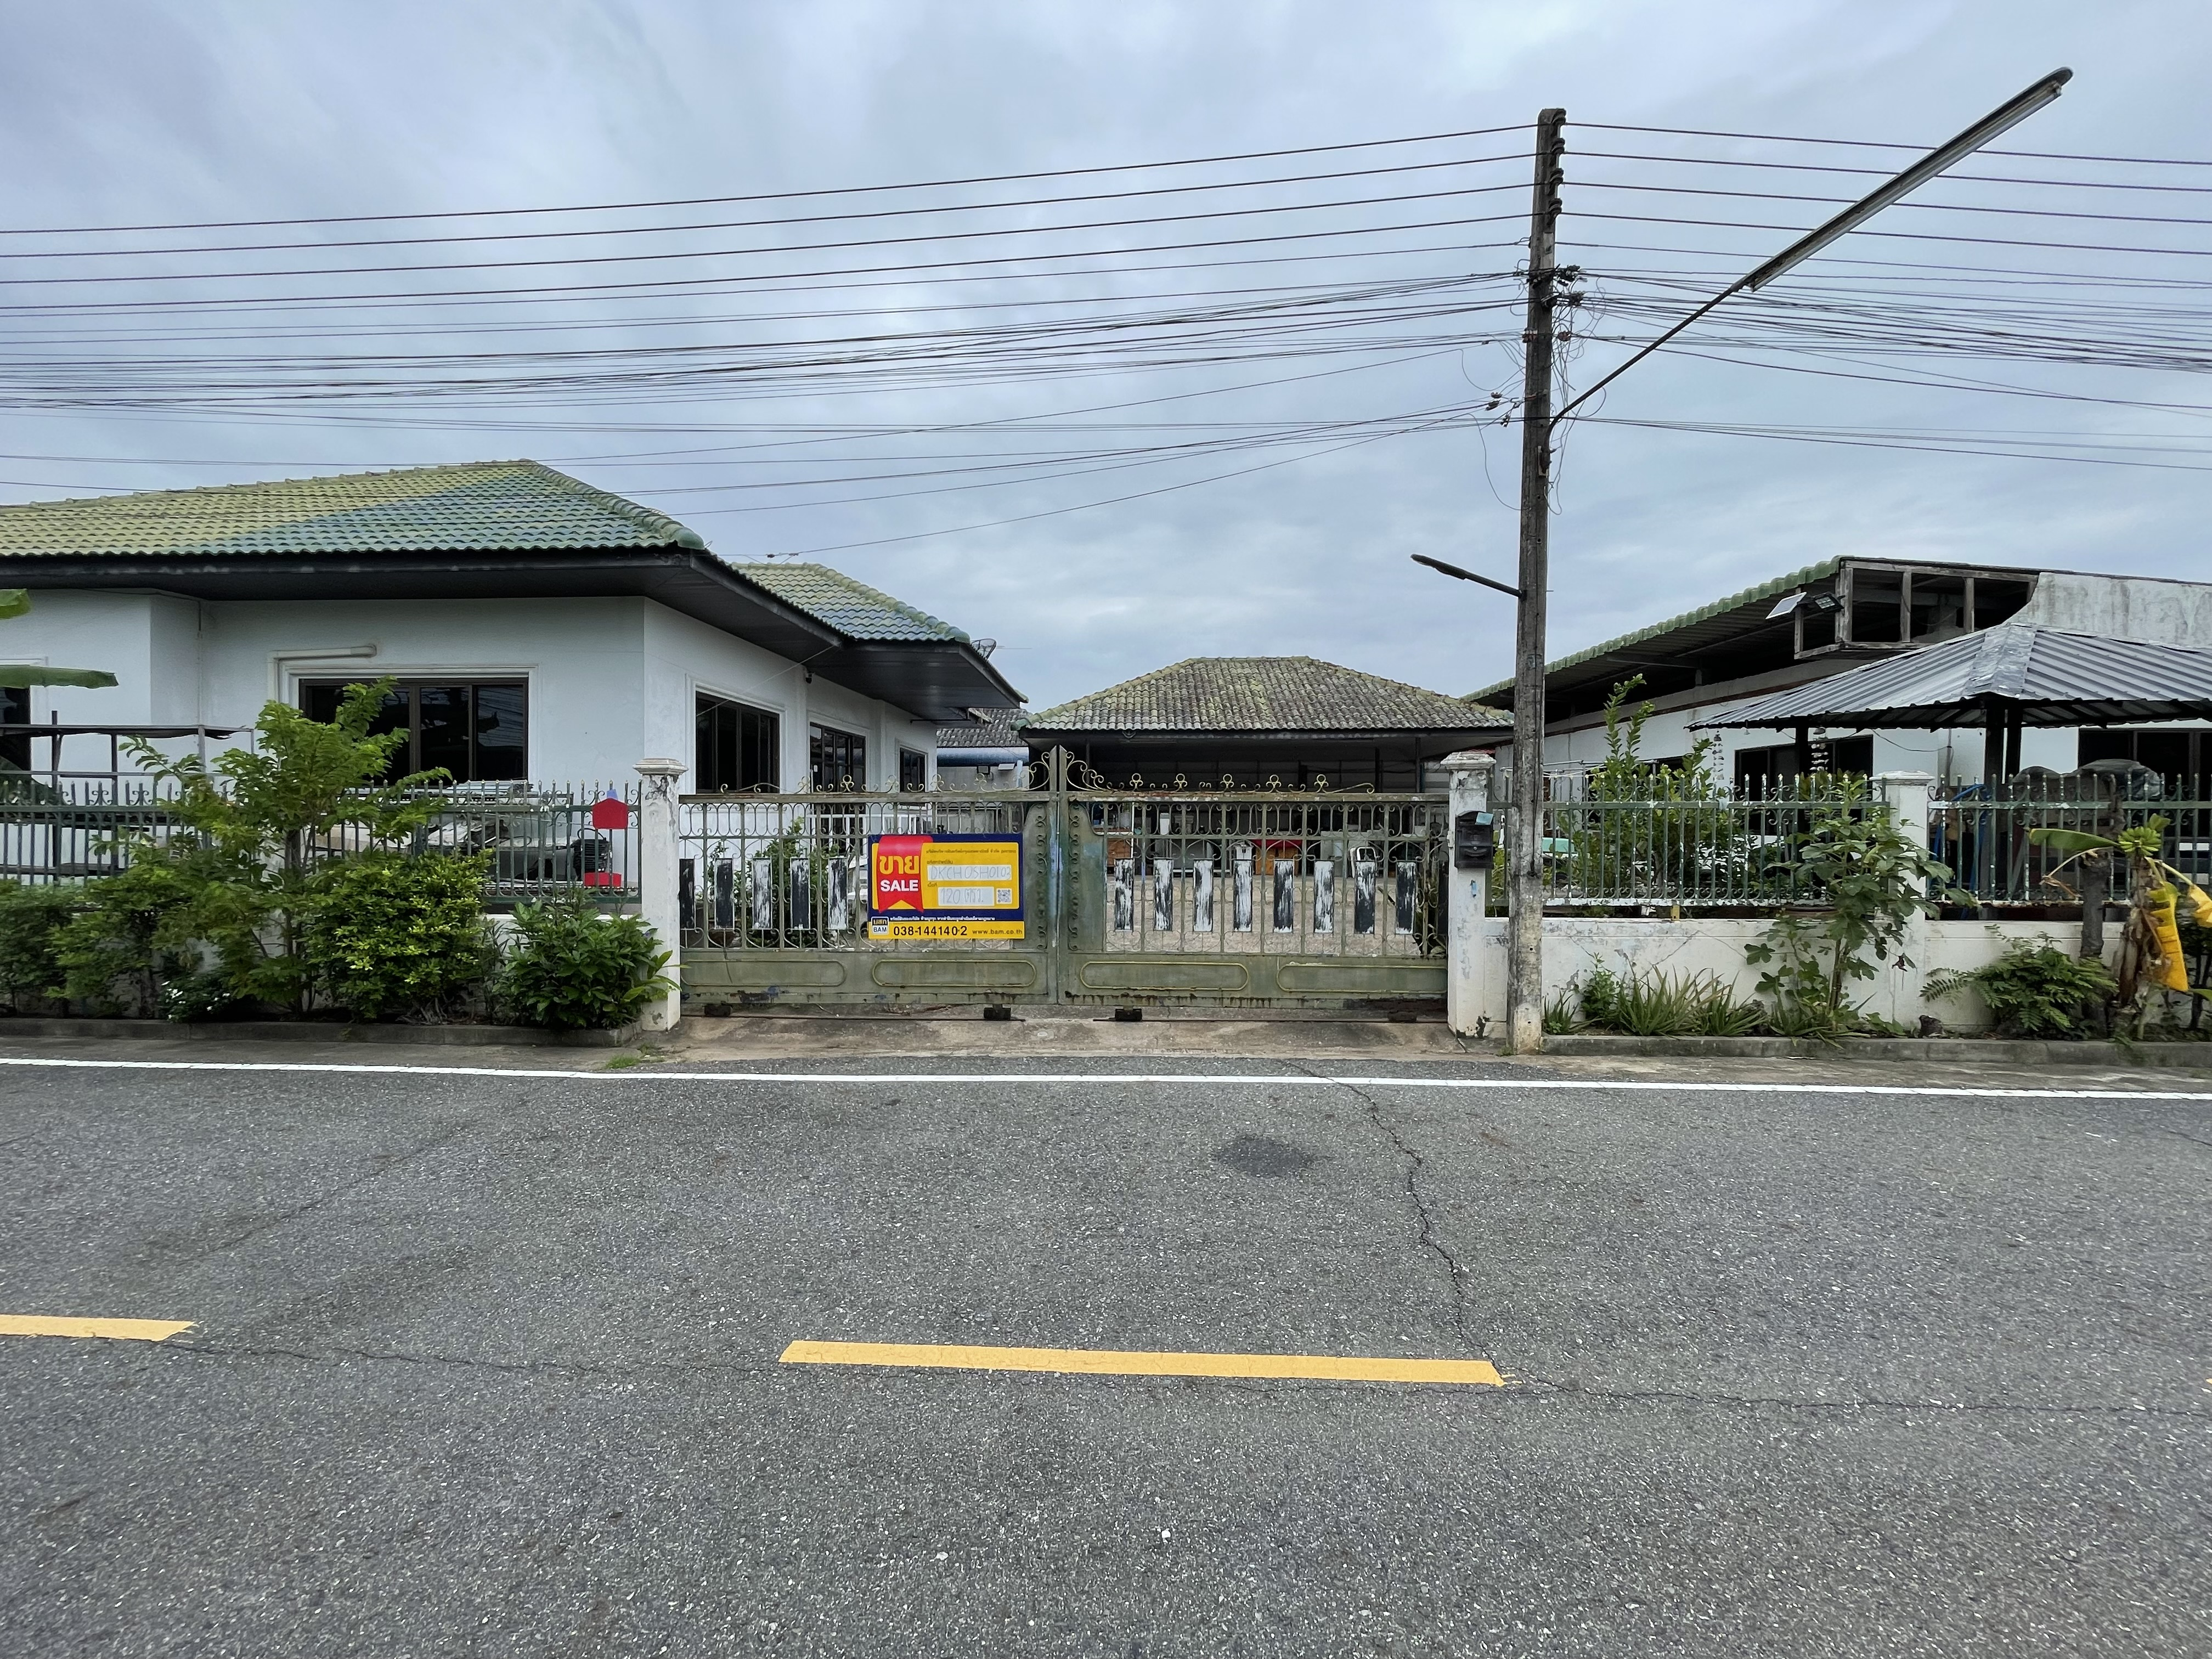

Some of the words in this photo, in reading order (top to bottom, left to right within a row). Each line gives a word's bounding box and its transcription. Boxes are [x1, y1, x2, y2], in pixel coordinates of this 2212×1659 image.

[879, 855, 919, 874] ขาย
[880, 879, 918, 891] SALE
[940, 888, 960, 904] 120
